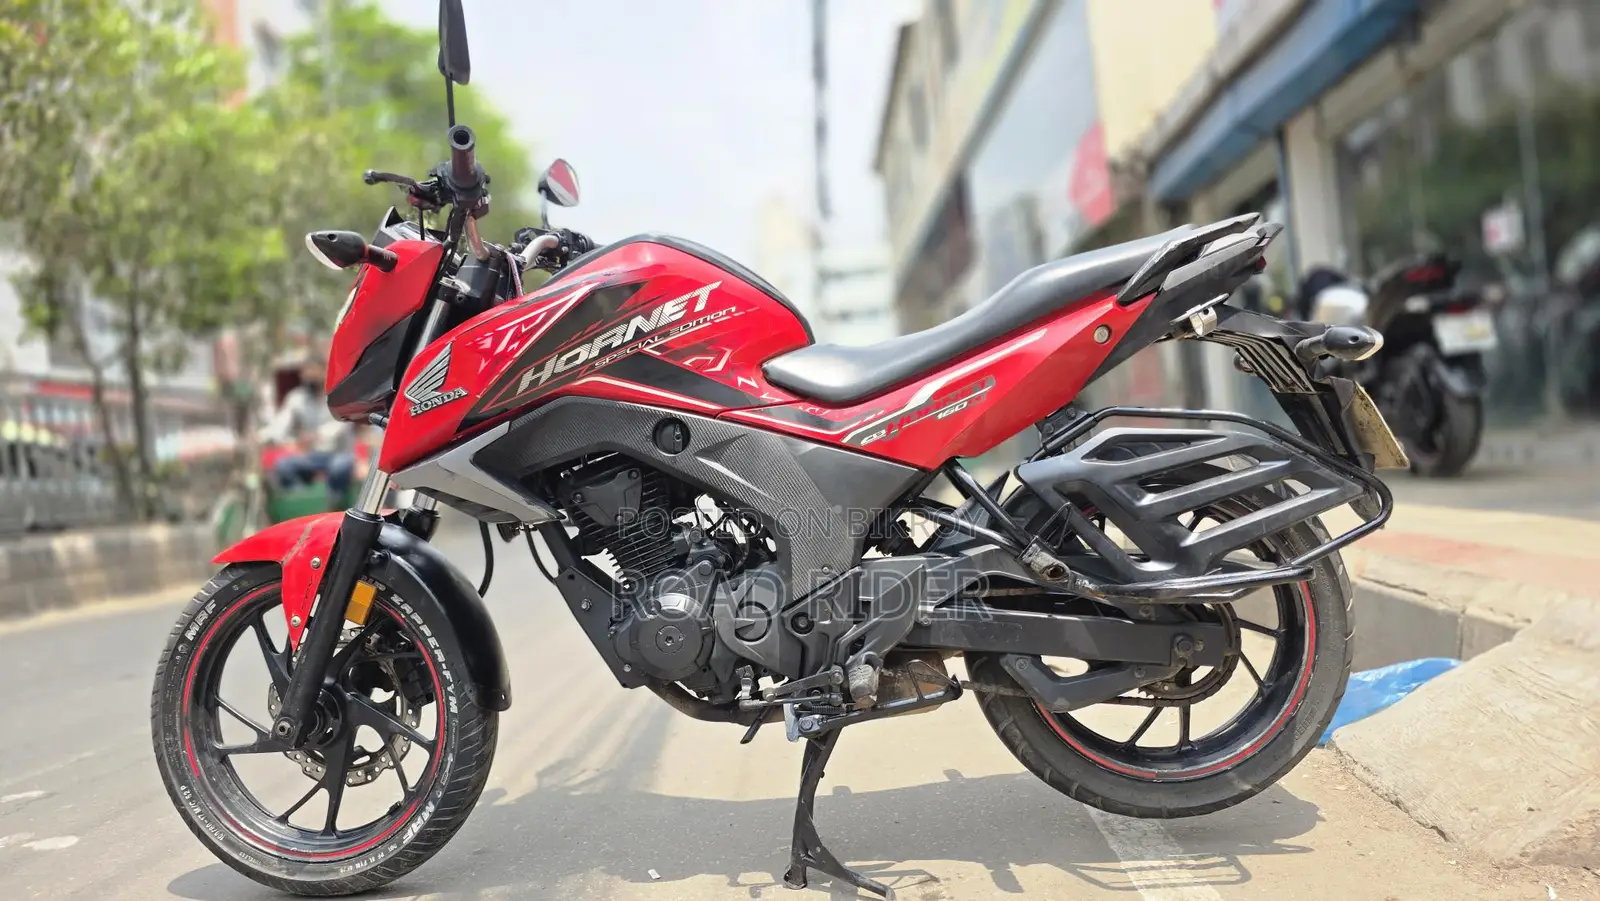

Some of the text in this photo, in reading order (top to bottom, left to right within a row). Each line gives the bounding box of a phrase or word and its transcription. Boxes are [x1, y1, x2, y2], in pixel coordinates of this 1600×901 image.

[516, 281, 723, 396] HORNET
[594, 306, 737, 369] SPECIAL EDITION
[409, 387, 469, 417] HONDA
[185, 599, 216, 641] MRF
[390, 593, 458, 714] ZAPPER-FYM
[403, 801, 435, 844] MRF
